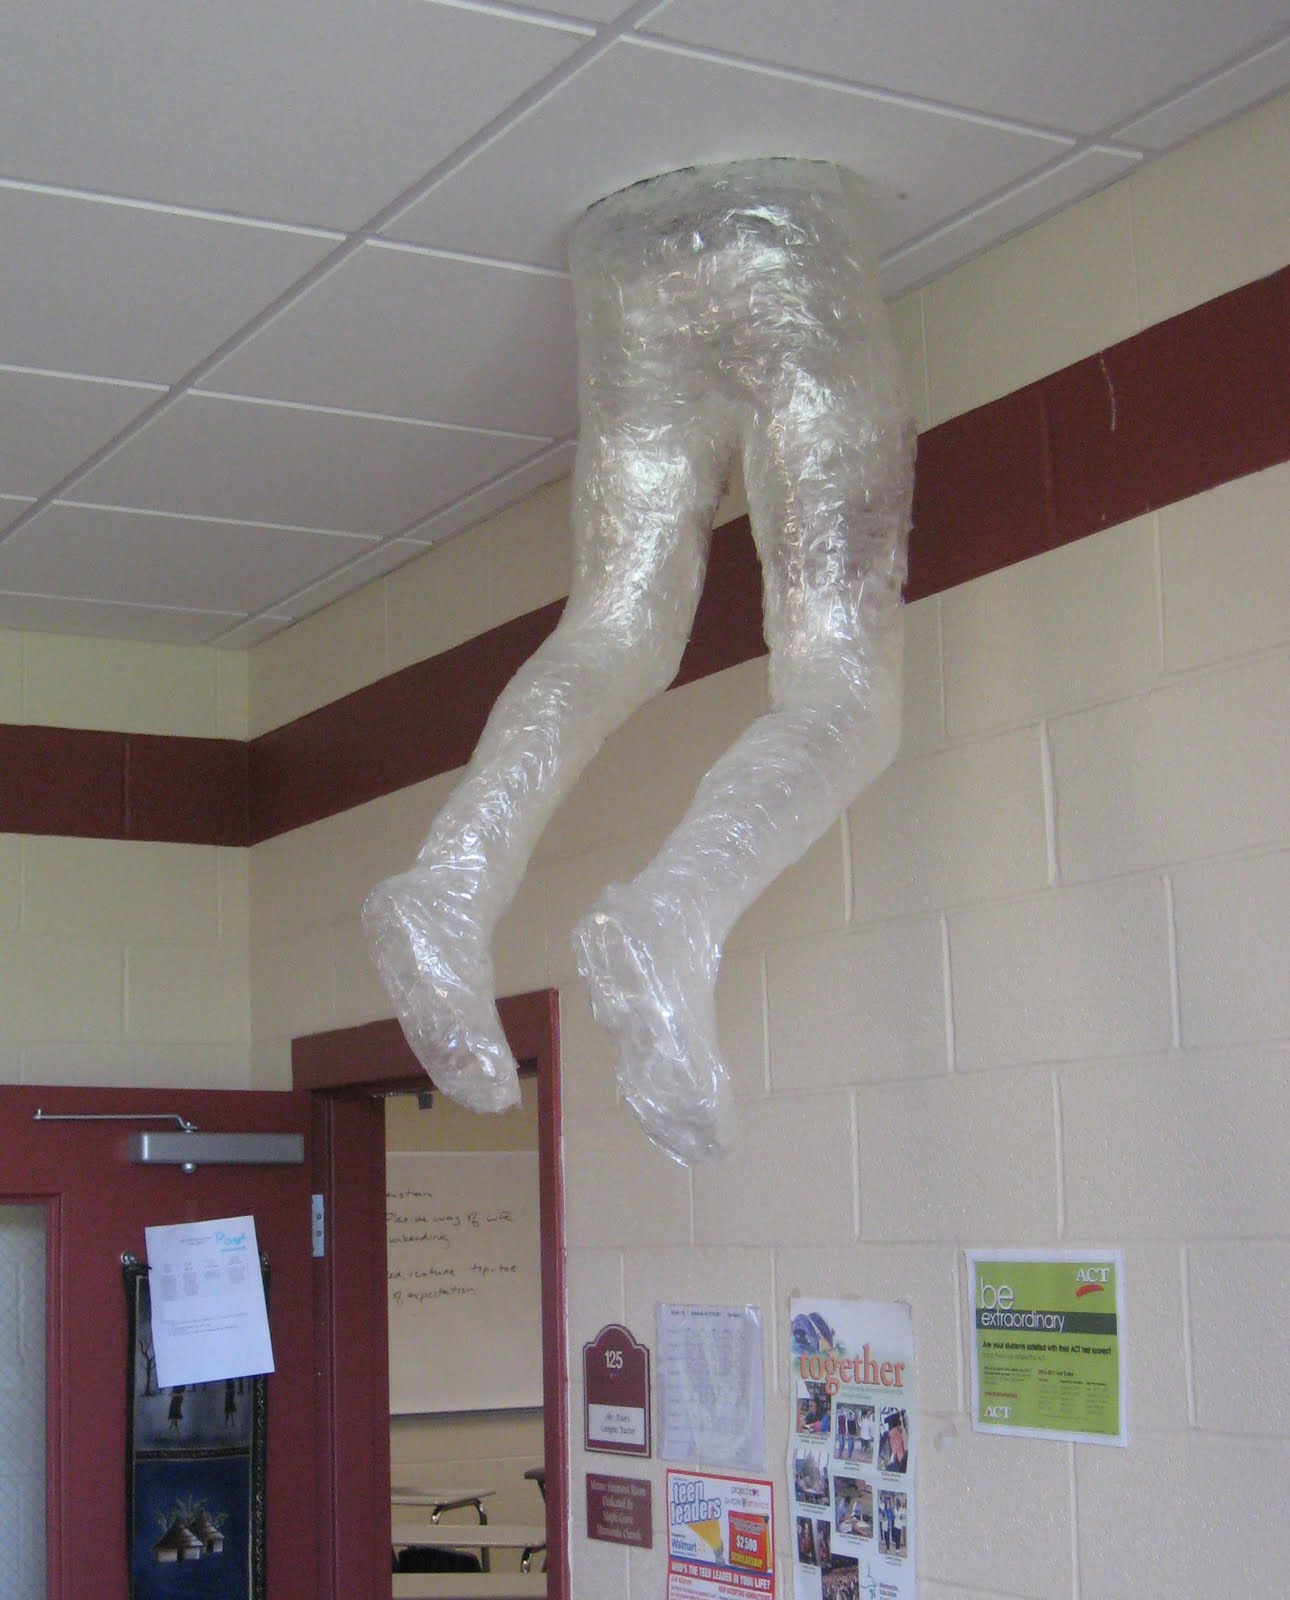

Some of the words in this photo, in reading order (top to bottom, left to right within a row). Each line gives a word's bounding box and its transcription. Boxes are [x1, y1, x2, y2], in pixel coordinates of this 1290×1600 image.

[1076, 1268, 1110, 1283] ACT
[981, 1277, 1014, 1310] be
[981, 1311, 1065, 1333] extraordinary
[993, 1342, 1003, 1350] your
[1004, 1342, 1025, 1350] students
[1070, 1345, 1081, 1353] ACT
[605, 1350, 623, 1369] 125
[800, 1343, 906, 1396] together
[984, 1406, 1012, 1419] ACT
[672, 1481, 704, 1503] teen
[671, 1498, 721, 1526] leaders
[671, 1538, 697, 1552] Walmart
[688, 1564, 698, 1575] THE
[698, 1566, 712, 1578] TEEN
[712, 1569, 732, 1582] LEADER
[732, 1573, 739, 1583] IN
[740, 1575, 754, 1587] YOUR
[754, 1577, 770, 1590] LIFE?
